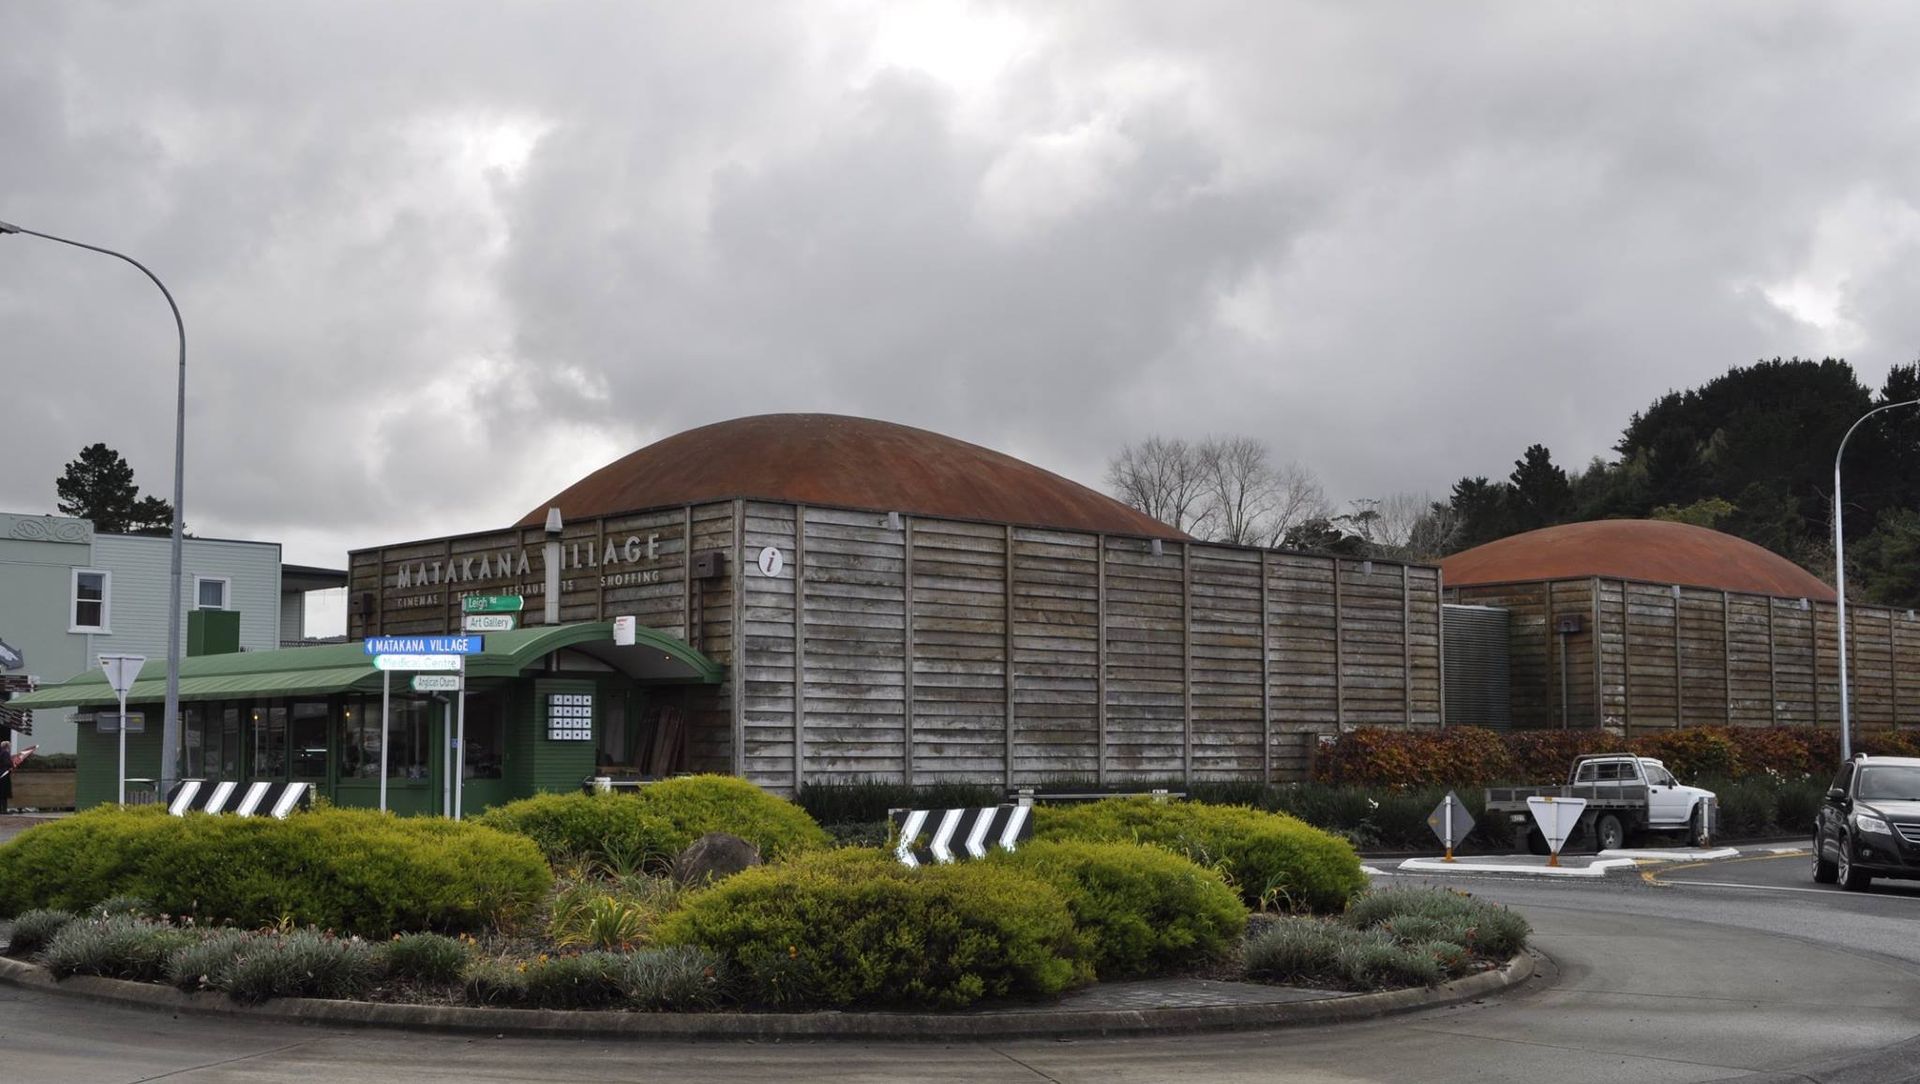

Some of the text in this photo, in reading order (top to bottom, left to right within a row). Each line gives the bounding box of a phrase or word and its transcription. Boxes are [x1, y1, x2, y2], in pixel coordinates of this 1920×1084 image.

[397, 549, 532, 589] MATAKANA
[397, 594, 438, 609] CINEMAS
[600, 570, 660, 588] SHOPPING
[468, 596, 488, 610] Leigh
[471, 616, 509, 629] Art Gallery
[375, 638, 469, 653] MATAKANA VILLAGE
